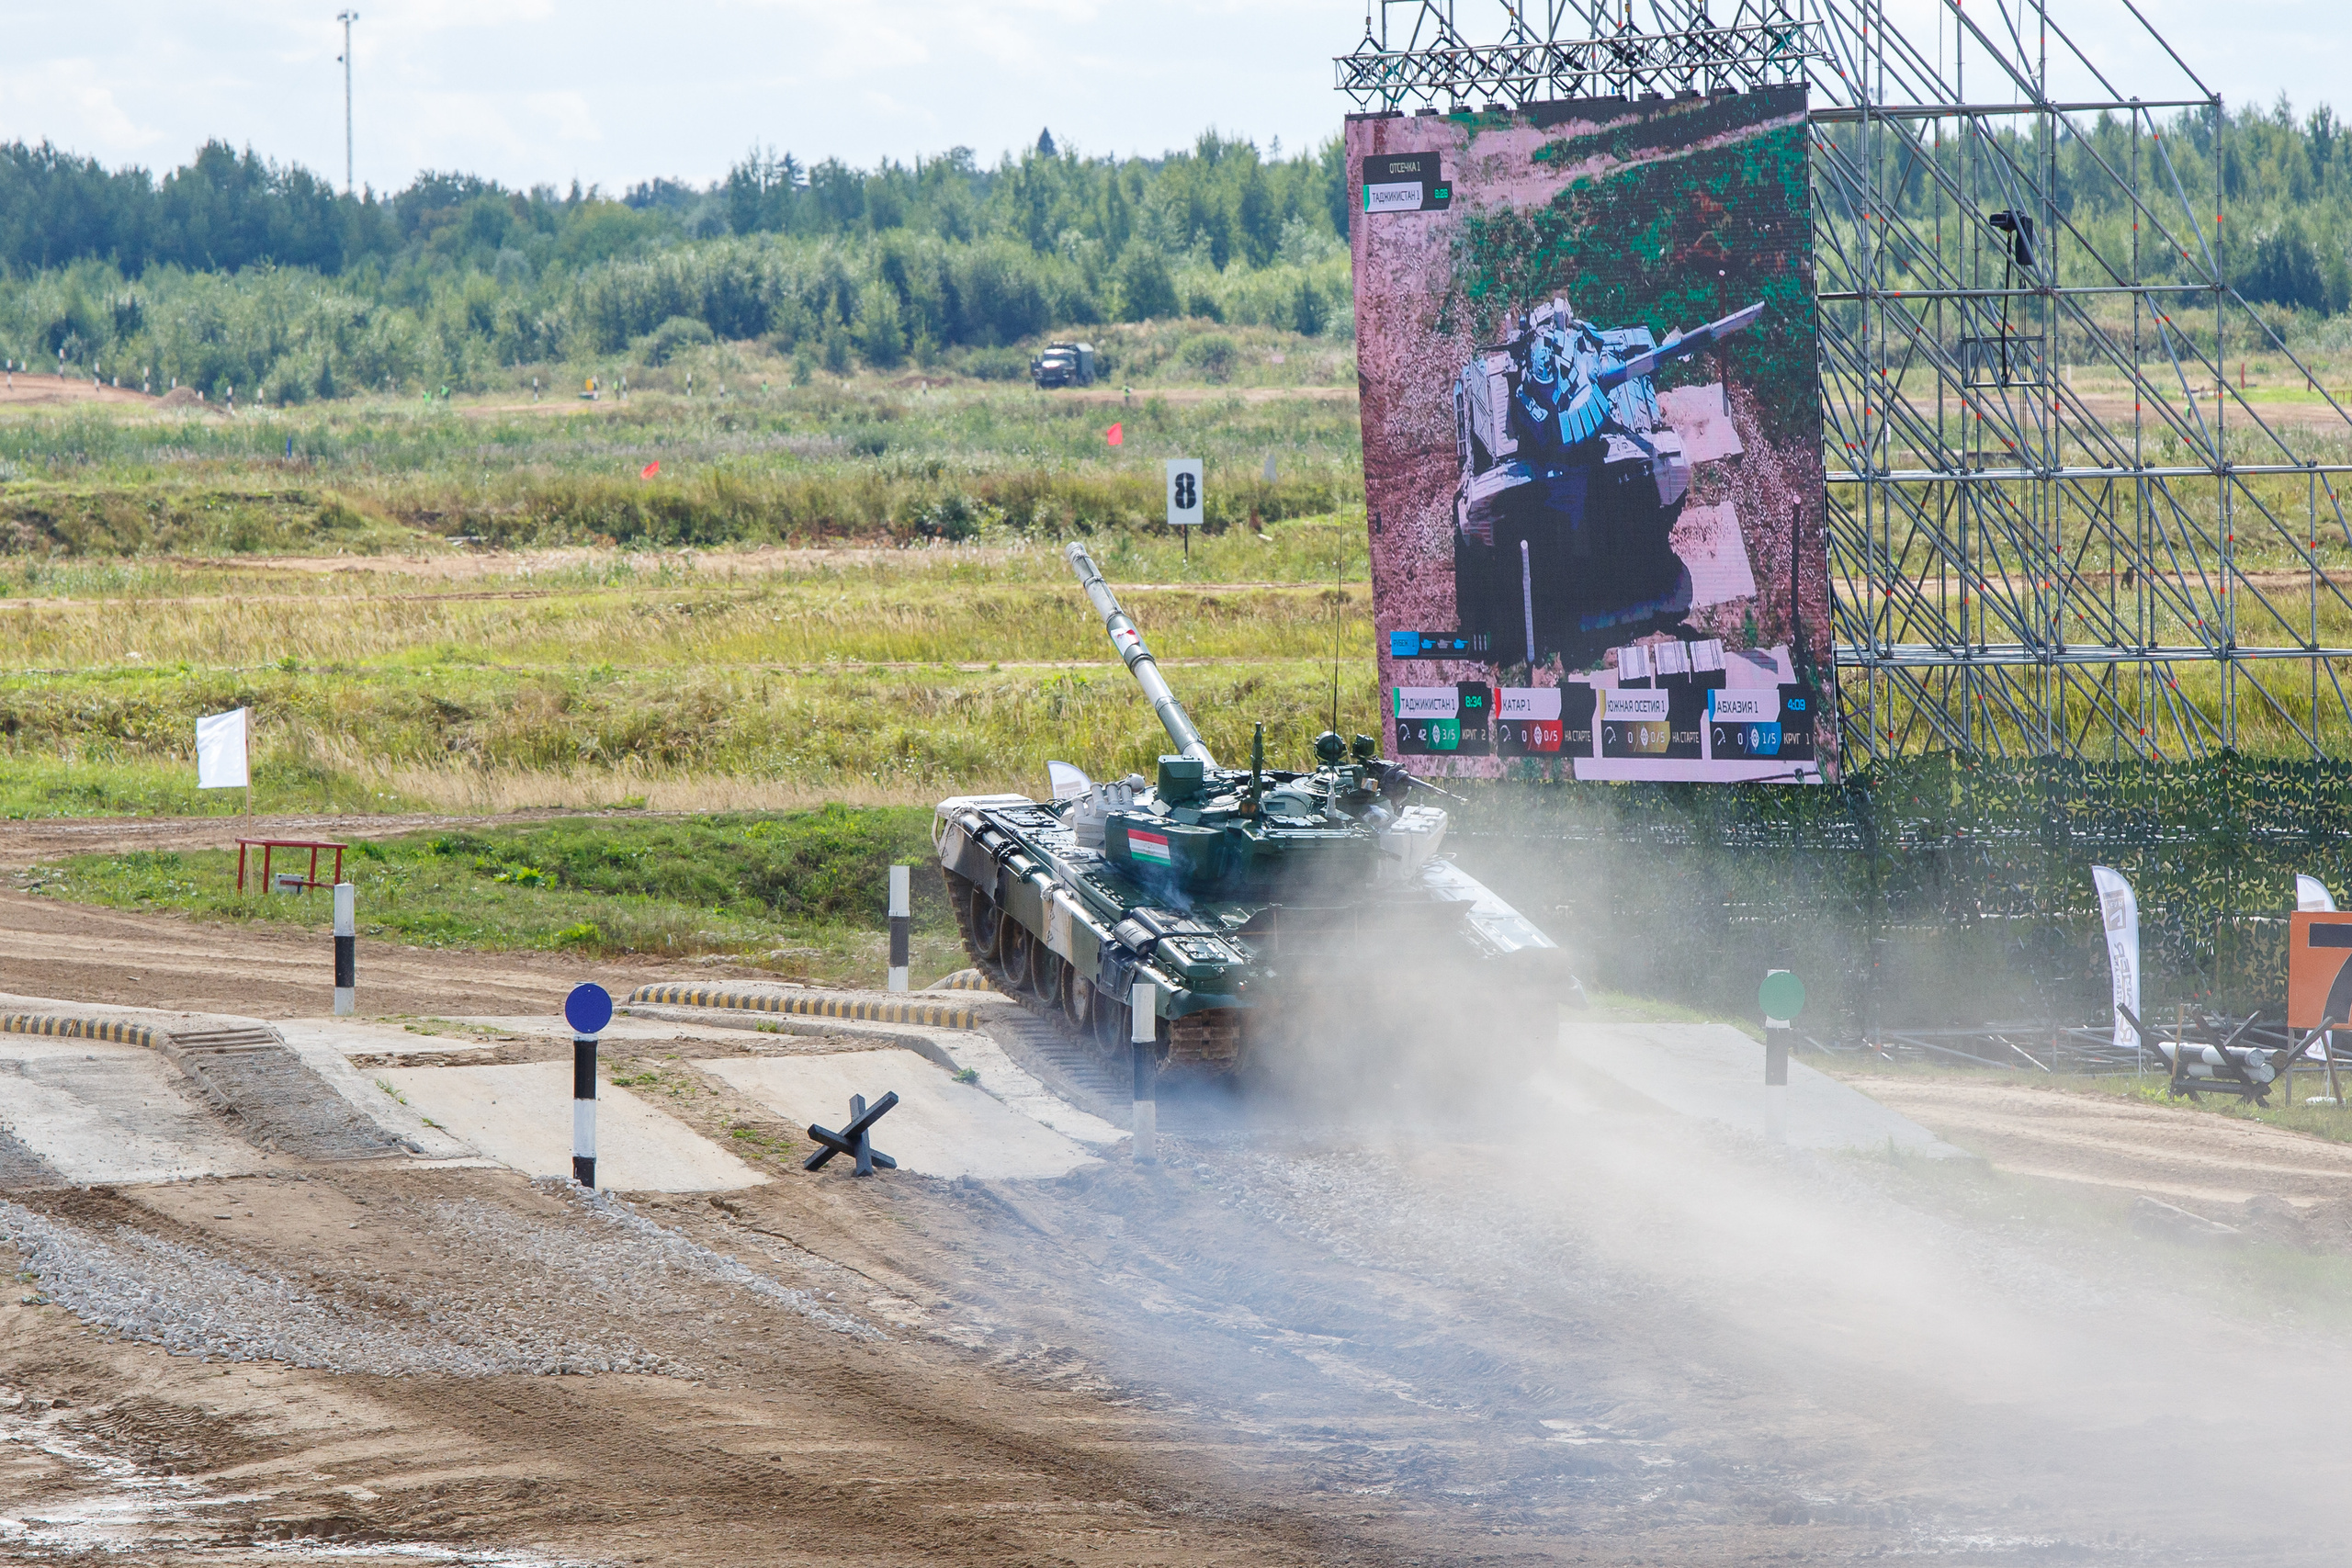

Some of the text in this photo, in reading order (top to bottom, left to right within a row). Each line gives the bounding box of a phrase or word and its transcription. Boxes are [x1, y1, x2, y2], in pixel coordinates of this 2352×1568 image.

[1389, 161, 1421, 174] ОТСЕЧКА 1
[1372, 190, 1420, 204] ТАДЖИКИСТАН 1
[1175, 472, 1196, 509] 8
[1401, 698, 1455, 712] ТАДЖИКИСТАН 1
[1464, 695, 1483, 708] 8:34
[1502, 699, 1531, 711] КАТАР 1
[1607, 700, 1666, 713] ЮЖНАЯ ОСЕТИЯ 1
[1716, 701, 1758, 714] АБХАЗИЯ 1
[1787, 698, 1806, 711] 4:09
[1418, 728, 1427, 740] 42
[1442, 728, 1456, 740] 3/5
[1462, 728, 1487, 740] КРУГ 2
[1521, 730, 1527, 742] 0
[1544, 730, 1558, 742] 0/5
[1564, 730, 1591, 742] НА СТАРТЕ
[1627, 731, 1634, 744] 0
[1650, 731, 1666, 743] 0/5
[1672, 731, 1700, 744] НА СТАРТЕ
[1737, 732, 1744, 745] 0
[1762, 732, 1777, 745] 1/5
[1783, 732, 1810, 745] КРУГ 1
[2307, 922, 2352, 1025] 7
